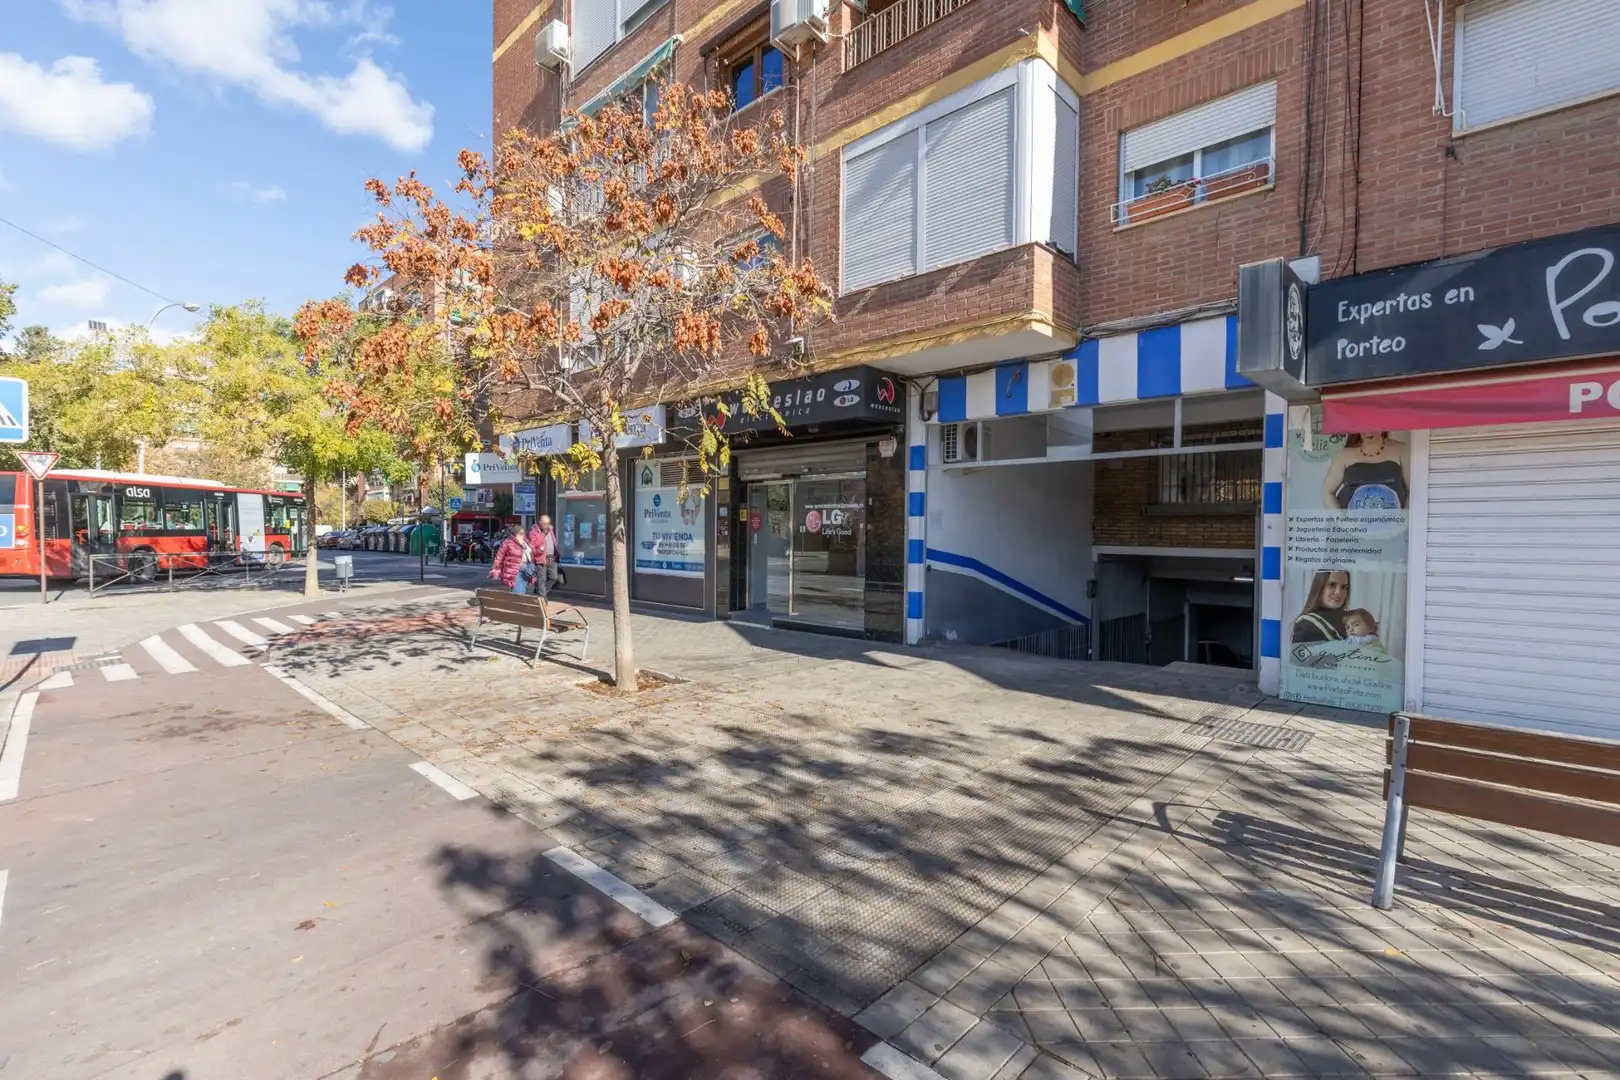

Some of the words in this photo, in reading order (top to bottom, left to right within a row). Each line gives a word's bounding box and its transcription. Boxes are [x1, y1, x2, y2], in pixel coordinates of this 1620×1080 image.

[1337, 292, 1433, 325] Expertas
[1444, 285, 1475, 305] en
[1336, 335, 1407, 361] Porteo
[125, 486, 151, 499] alsa
[822, 509, 842, 525] LG
[1296, 516, 1324, 524] Expertas
[652, 532, 661, 540] TU
[661, 532, 694, 542] VIVIENDA
[1322, 556, 1356, 564] originales
